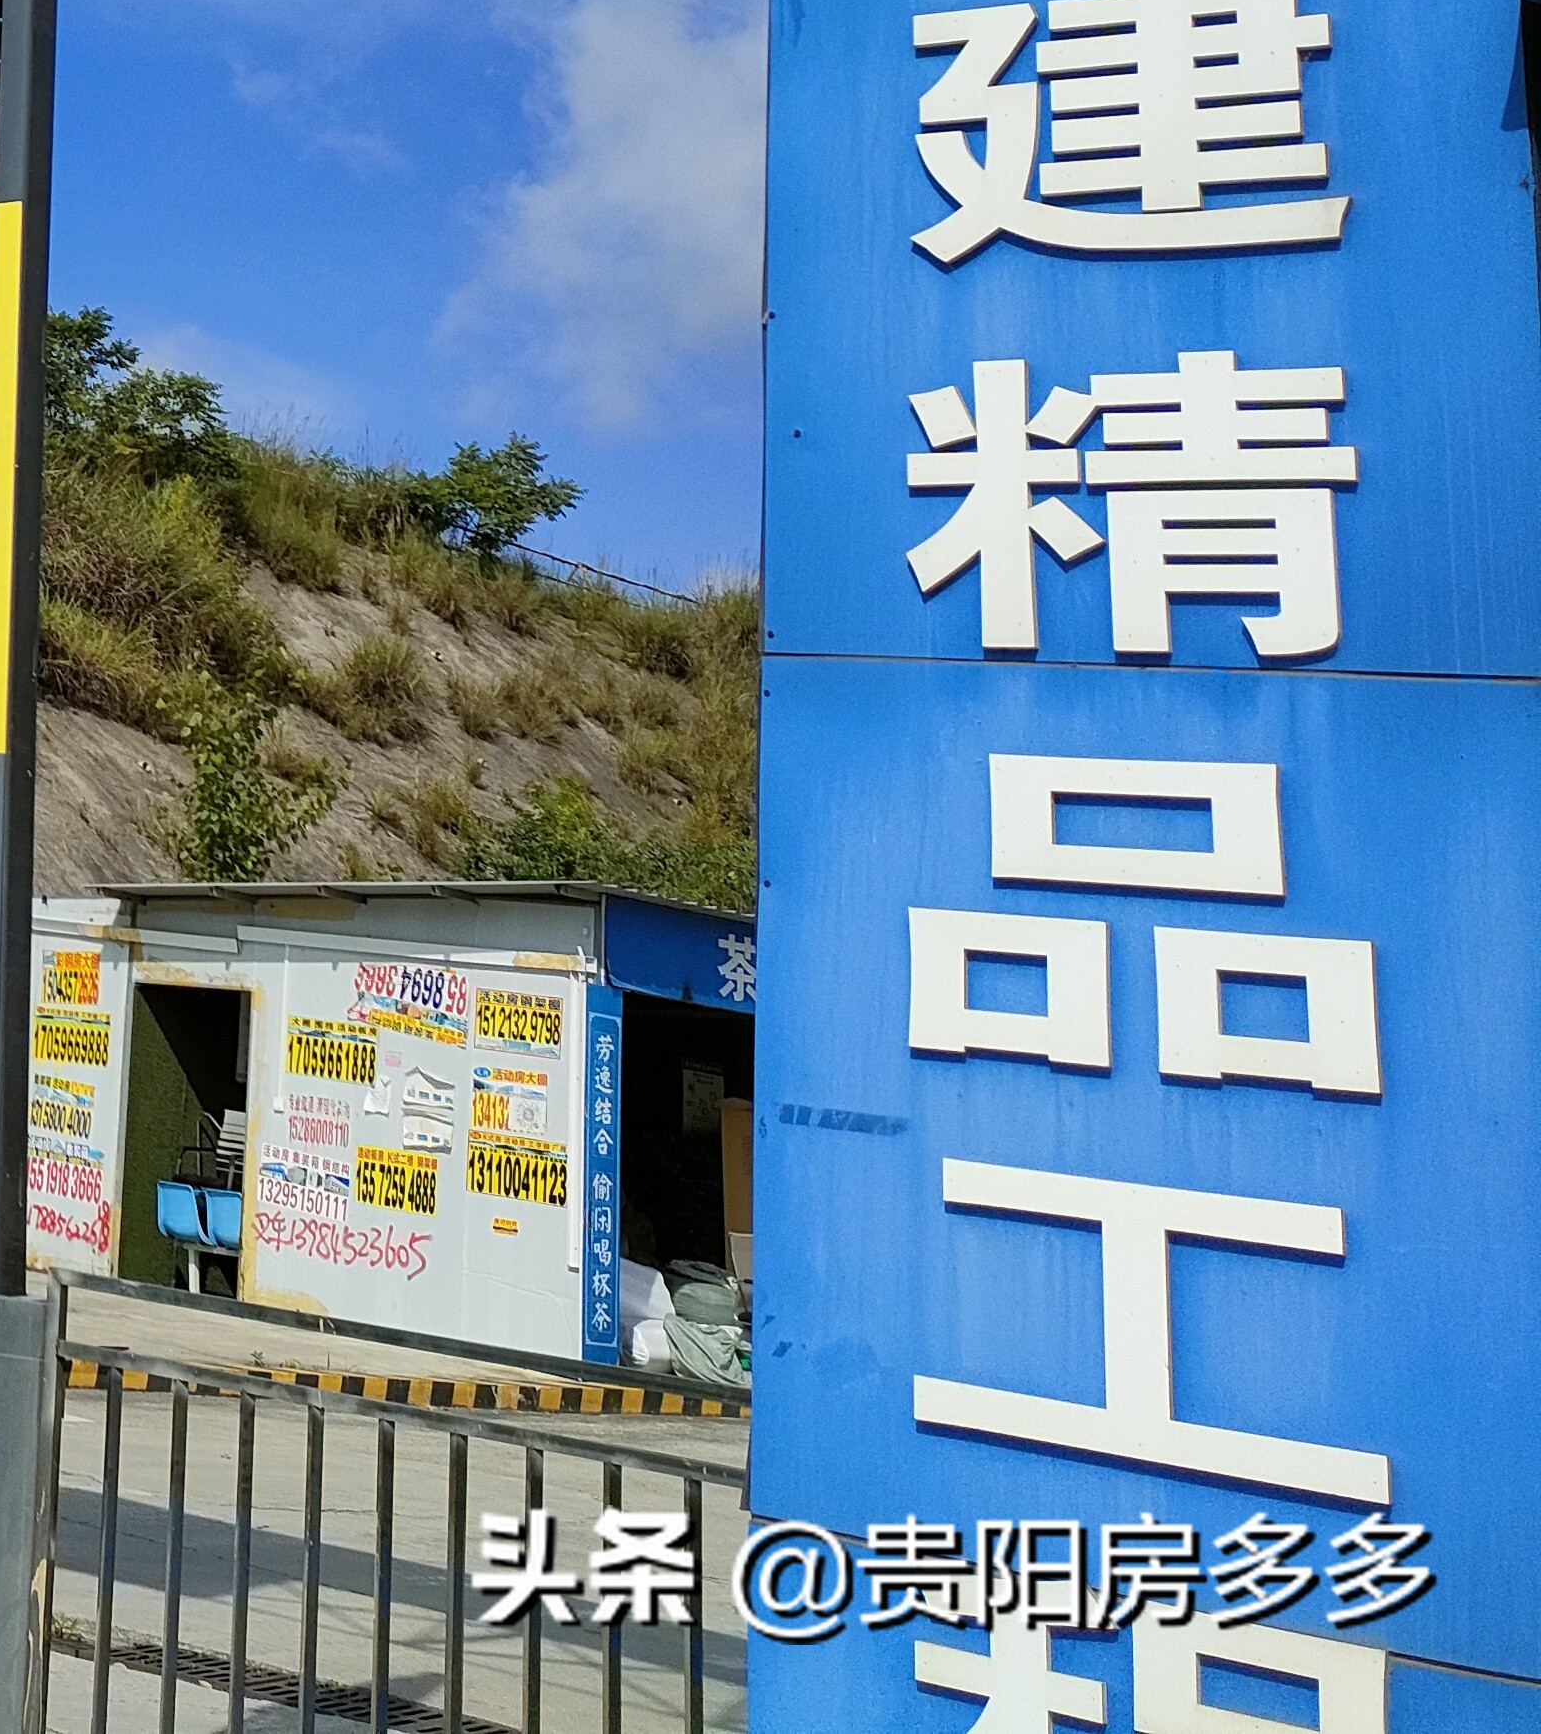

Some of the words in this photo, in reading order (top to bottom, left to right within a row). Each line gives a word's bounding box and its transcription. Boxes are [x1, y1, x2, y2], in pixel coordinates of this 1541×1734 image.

[717, 933, 756, 1003] 茶
[288, 1035, 376, 1085] 17059661888
[593, 1033, 615, 1156] 劳逸结合
[259, 1177, 348, 1222] 13295150111
[469, 1151, 567, 1206] 13110041123
[591, 1171, 614, 1333] 偷闲喝杯茶
